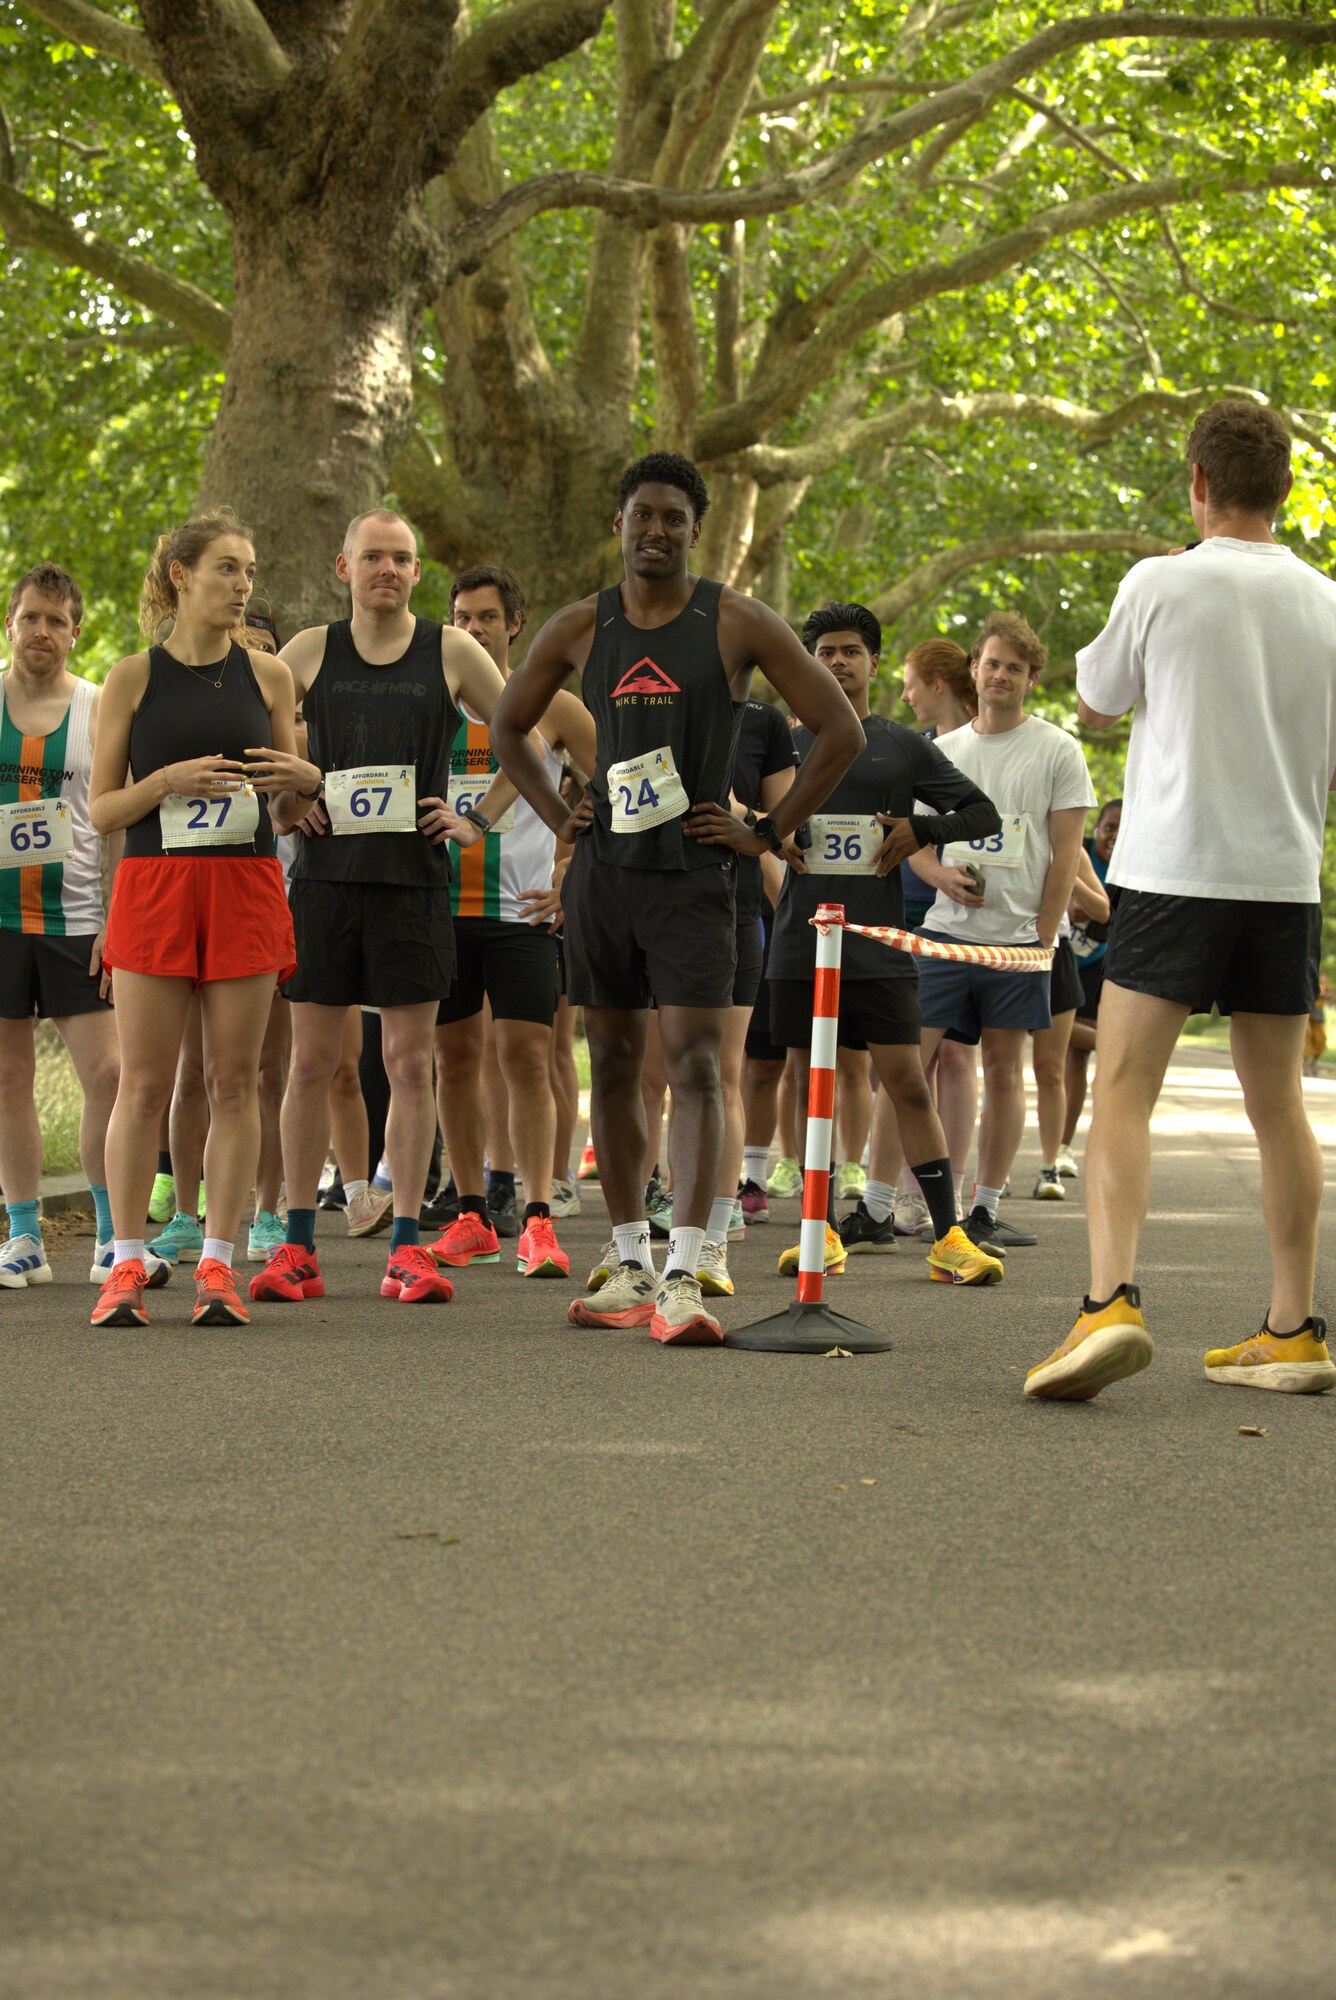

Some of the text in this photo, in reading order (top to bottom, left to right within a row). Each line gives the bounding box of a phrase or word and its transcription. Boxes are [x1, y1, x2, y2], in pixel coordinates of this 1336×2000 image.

[615, 696, 674, 708] NIKE TRAIL
[656, 752, 663, 764] A
[351, 772, 389, 780] AFFORDABLE
[400, 769, 407, 779] A
[350, 787, 392, 818] 67
[455, 792, 486, 818] 6
[618, 777, 660, 816] 24
[10, 806, 45, 815] AFFORDABLE
[56, 802, 62, 811] A
[186, 797, 232, 830] 27
[10, 820, 51, 852] 65
[823, 833, 862, 861] 36
